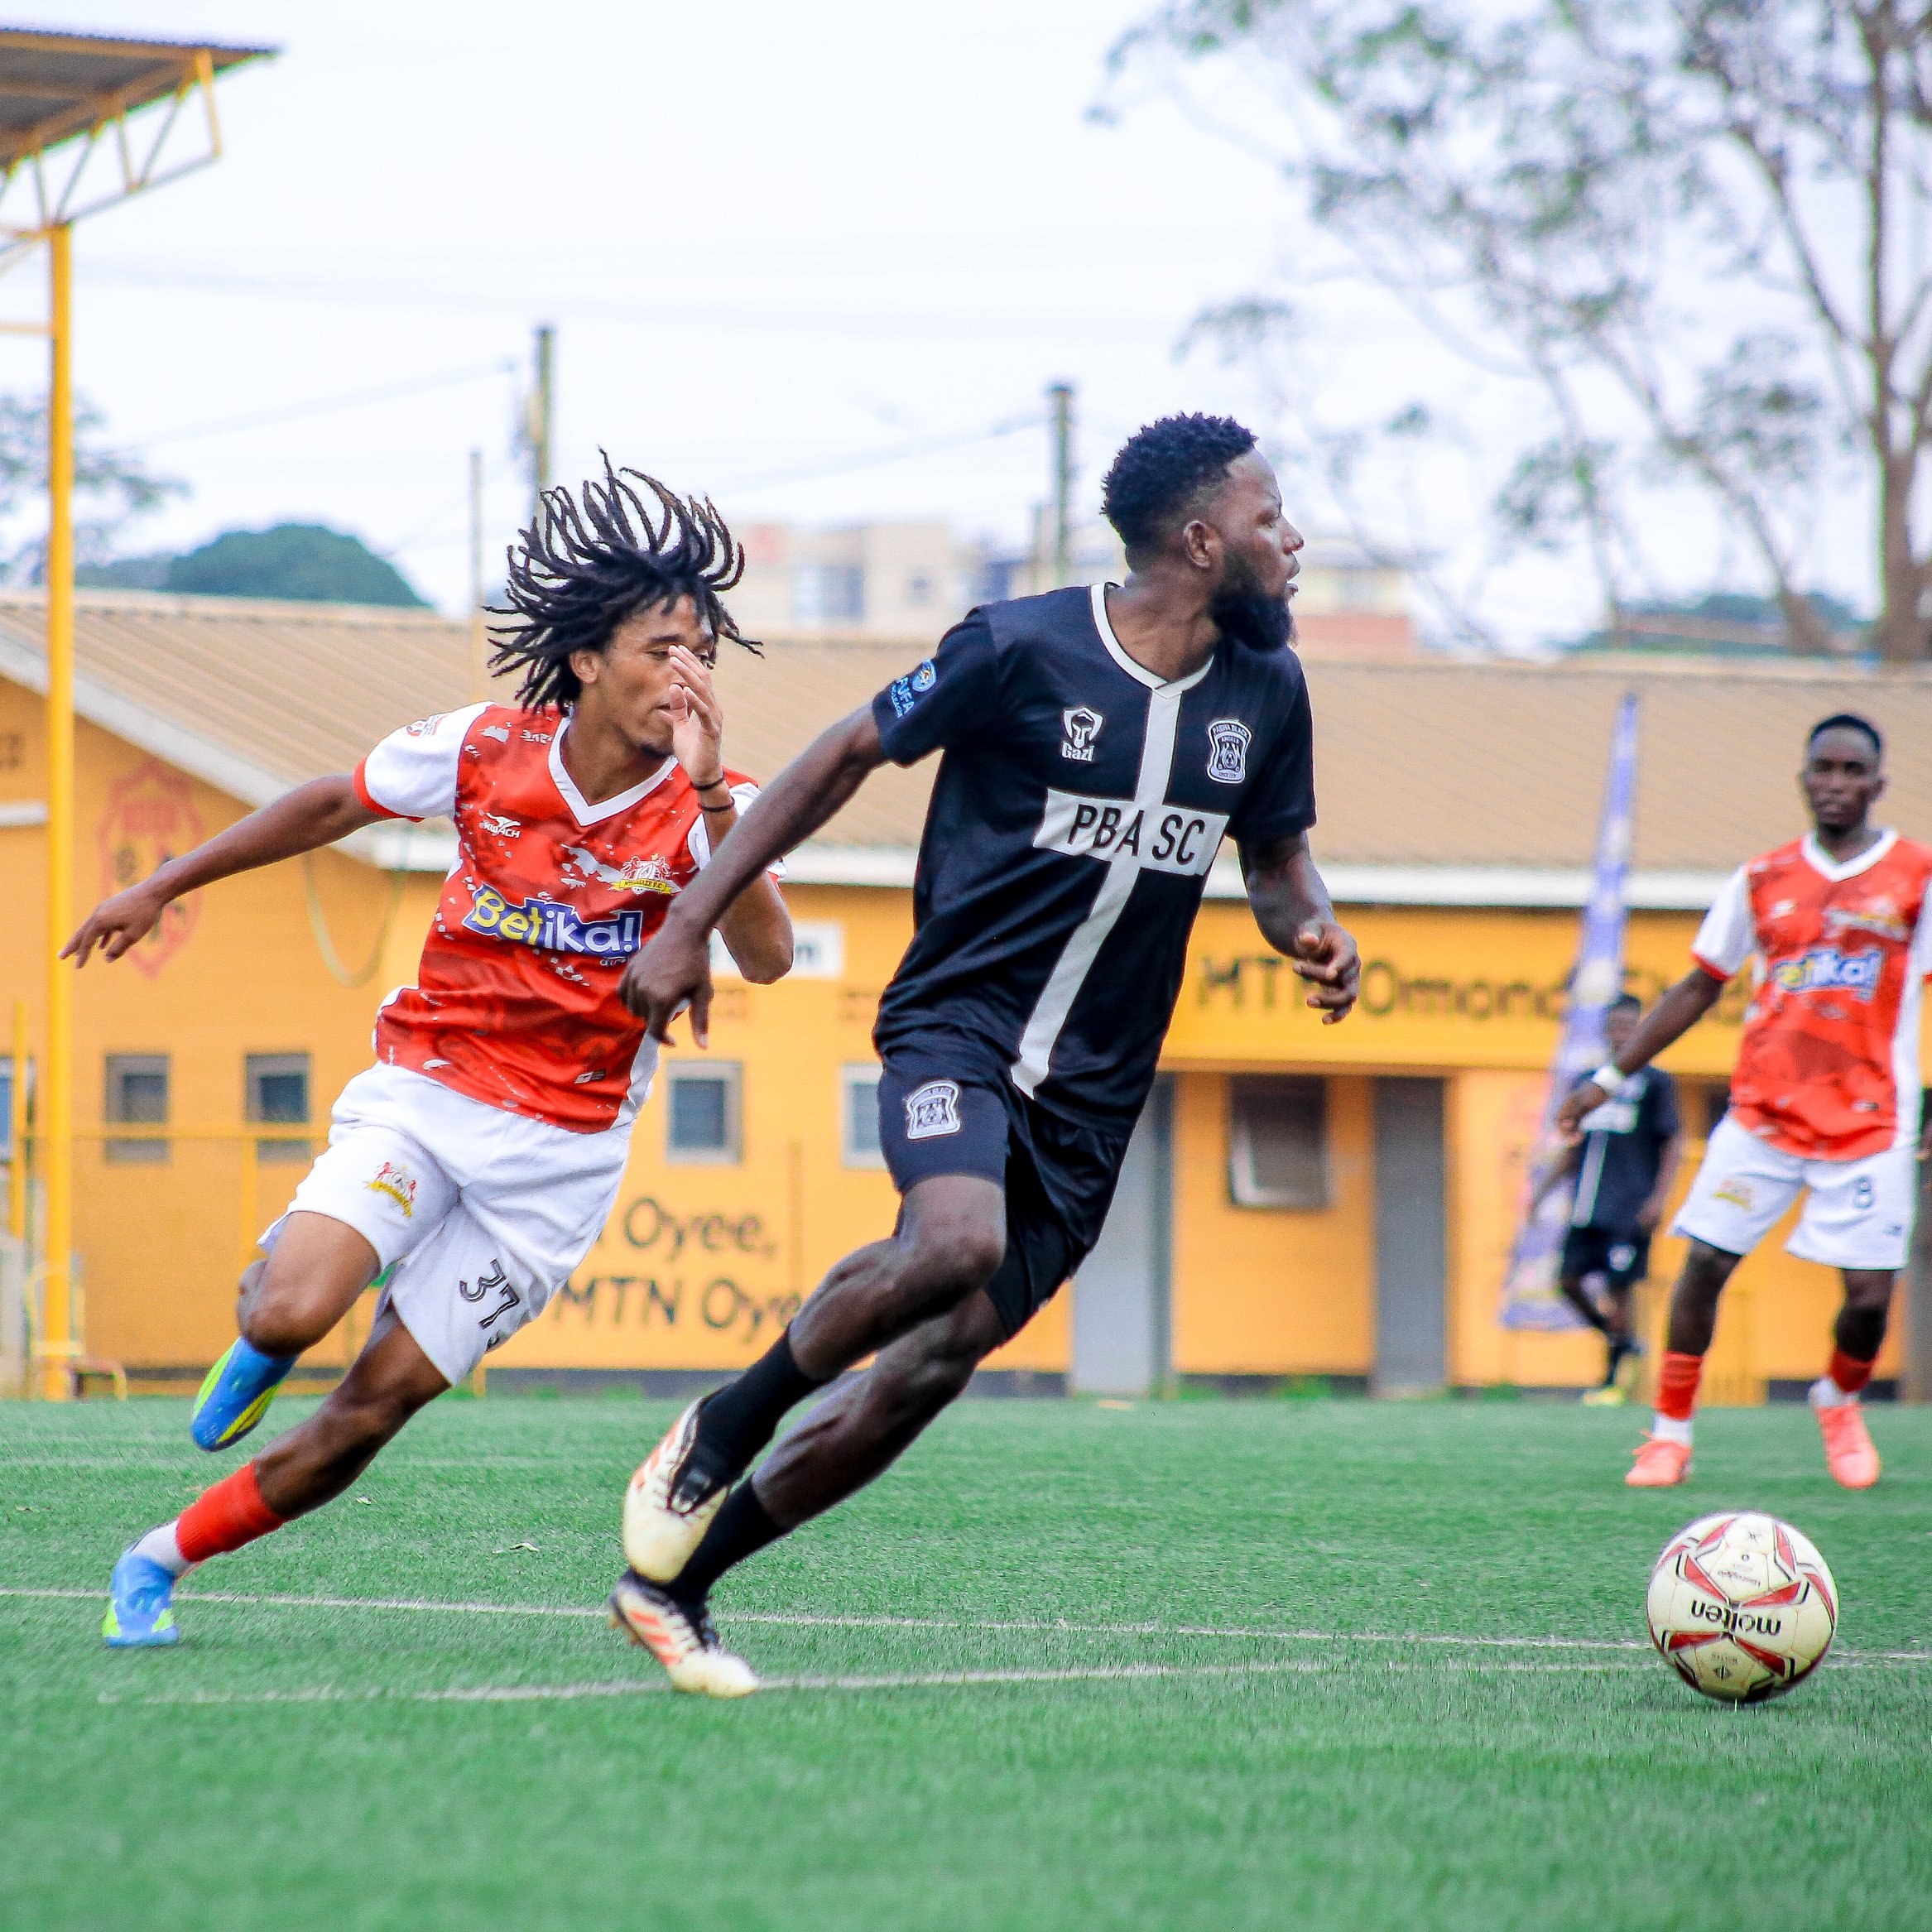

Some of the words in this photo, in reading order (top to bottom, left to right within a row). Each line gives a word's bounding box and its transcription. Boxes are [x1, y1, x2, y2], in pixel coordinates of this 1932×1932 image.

[1062, 741, 1094, 762] Gazi
[1068, 803, 1146, 858] PBA
[1152, 814, 1206, 866] SC
[471, 890, 635, 953] Betika!
[1853, 1175, 1875, 1209] 8
[623, 1196, 776, 1262] Oyee,
[459, 1257, 521, 1331] 37
[555, 1275, 683, 1324] MTN
[1690, 1599, 1781, 1636] molten
